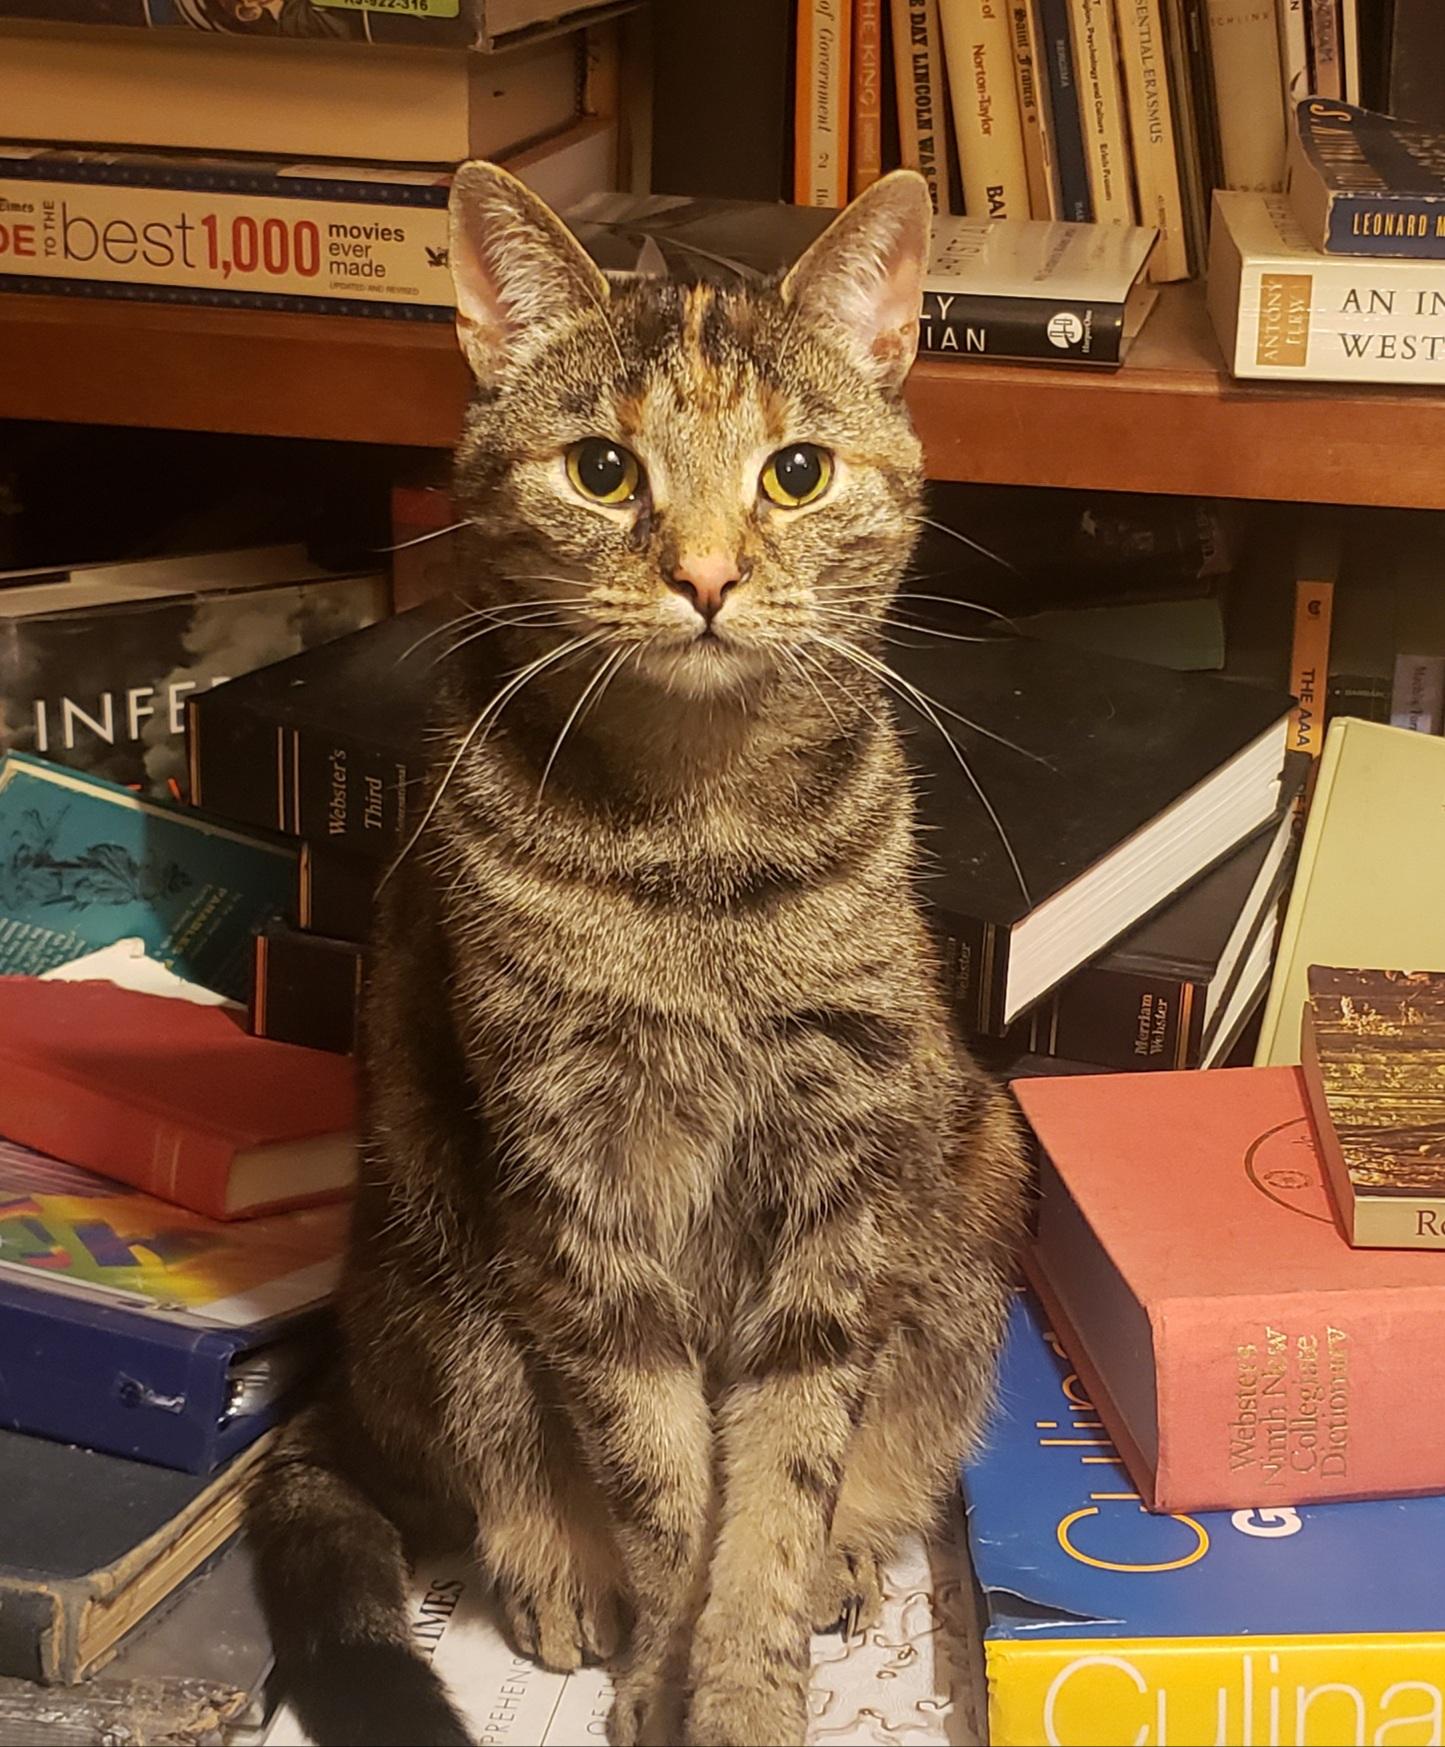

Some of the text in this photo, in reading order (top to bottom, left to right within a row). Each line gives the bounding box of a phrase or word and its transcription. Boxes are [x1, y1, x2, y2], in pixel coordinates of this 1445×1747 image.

[816, 0, 835, 21] of
[910, 12, 928, 47] DAY
[817, 28, 834, 132] Government
[860, 44, 876, 105] KING
[912, 52, 934, 130] LINCOLN
[972, 44, 992, 136] Norton-Taylor
[1014, 8, 1035, 108] Saint Francis
[1143, 69, 1162, 144] ERASMUS
[43, 200, 57, 257] TO THE
[62, 201, 321, 279] best 1,000
[328, 222, 405, 242] movies
[328, 242, 372, 258] ever
[1352, 212, 1428, 237] LEONARD
[329, 259, 386, 278] made
[1339, 288, 1397, 315] AN
[1264, 281, 1283, 360] ANTONY
[1337, 332, 1445, 361] WEST
[36, 676, 232, 752] INFE
[1297, 667, 1316, 747] THE AAA
[328, 748, 347, 836] Webster's
[364, 776, 382, 829] Third
[1134, 994, 1153, 1056] Merriam
[1150, 998, 1168, 1055] Webster
[1259, 1326, 1288, 1487] Ninth New
[1289, 1334, 1325, 1474] Collegiate
[1320, 1325, 1348, 1479] Dictionary
